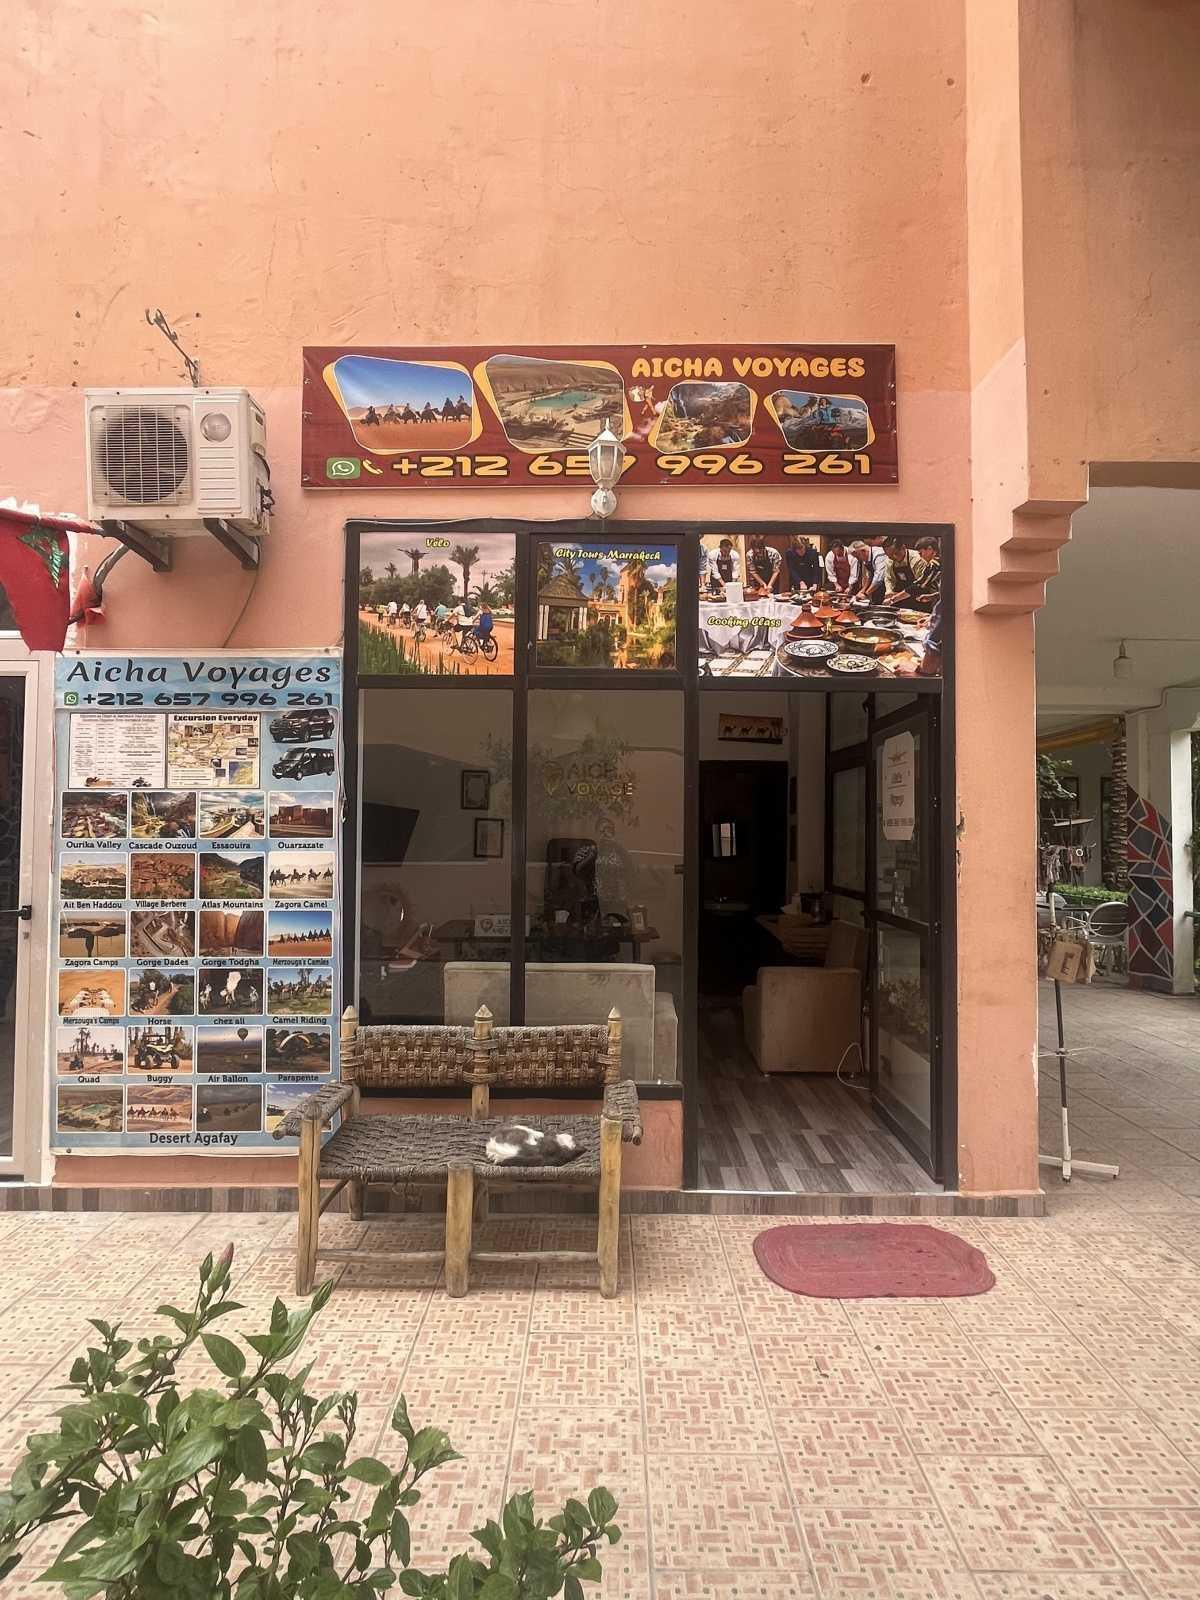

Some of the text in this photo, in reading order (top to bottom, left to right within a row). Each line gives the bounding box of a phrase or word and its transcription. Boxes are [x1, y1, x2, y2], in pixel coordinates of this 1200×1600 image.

[631, 356, 866, 379] AICHA VOYAGES
[392, 455, 509, 477] +212
[655, 454, 764, 475] 996
[782, 454, 873, 475] 261
[555, 547, 576, 560] City
[606, 549, 661, 562] Marrakech
[706, 616, 781, 628] Cooking Class
[67, 661, 331, 689] Aicha Voyages
[83, 693, 333, 706] +212 657 996 261
[66, 841, 122, 849] Ourika Valley
[129, 842, 197, 850] Cascade Ouzoud
[212, 841, 251, 849] Essaouira
[76, 901, 91, 909] Ben
[92, 901, 122, 909] Haddou
[136, 900, 159, 908] Village
[202, 900, 263, 908] Atlas Mountains
[274, 900, 328, 909] Zagora Camel
[65, 958, 119, 967] Zagora Camps
[136, 958, 189, 967] Gorge Dades
[201, 958, 227, 967] Gorge
[147, 1017, 172, 1025] Horse
[272, 1016, 327, 1025] Camel Riding
[78, 1075, 100, 1083] Quad
[147, 1075, 173, 1084] Buggy
[207, 1075, 248, 1083] Air Ballon
[277, 1074, 319, 1082] Parapente
[149, 1132, 238, 1146] Desert Agafay
